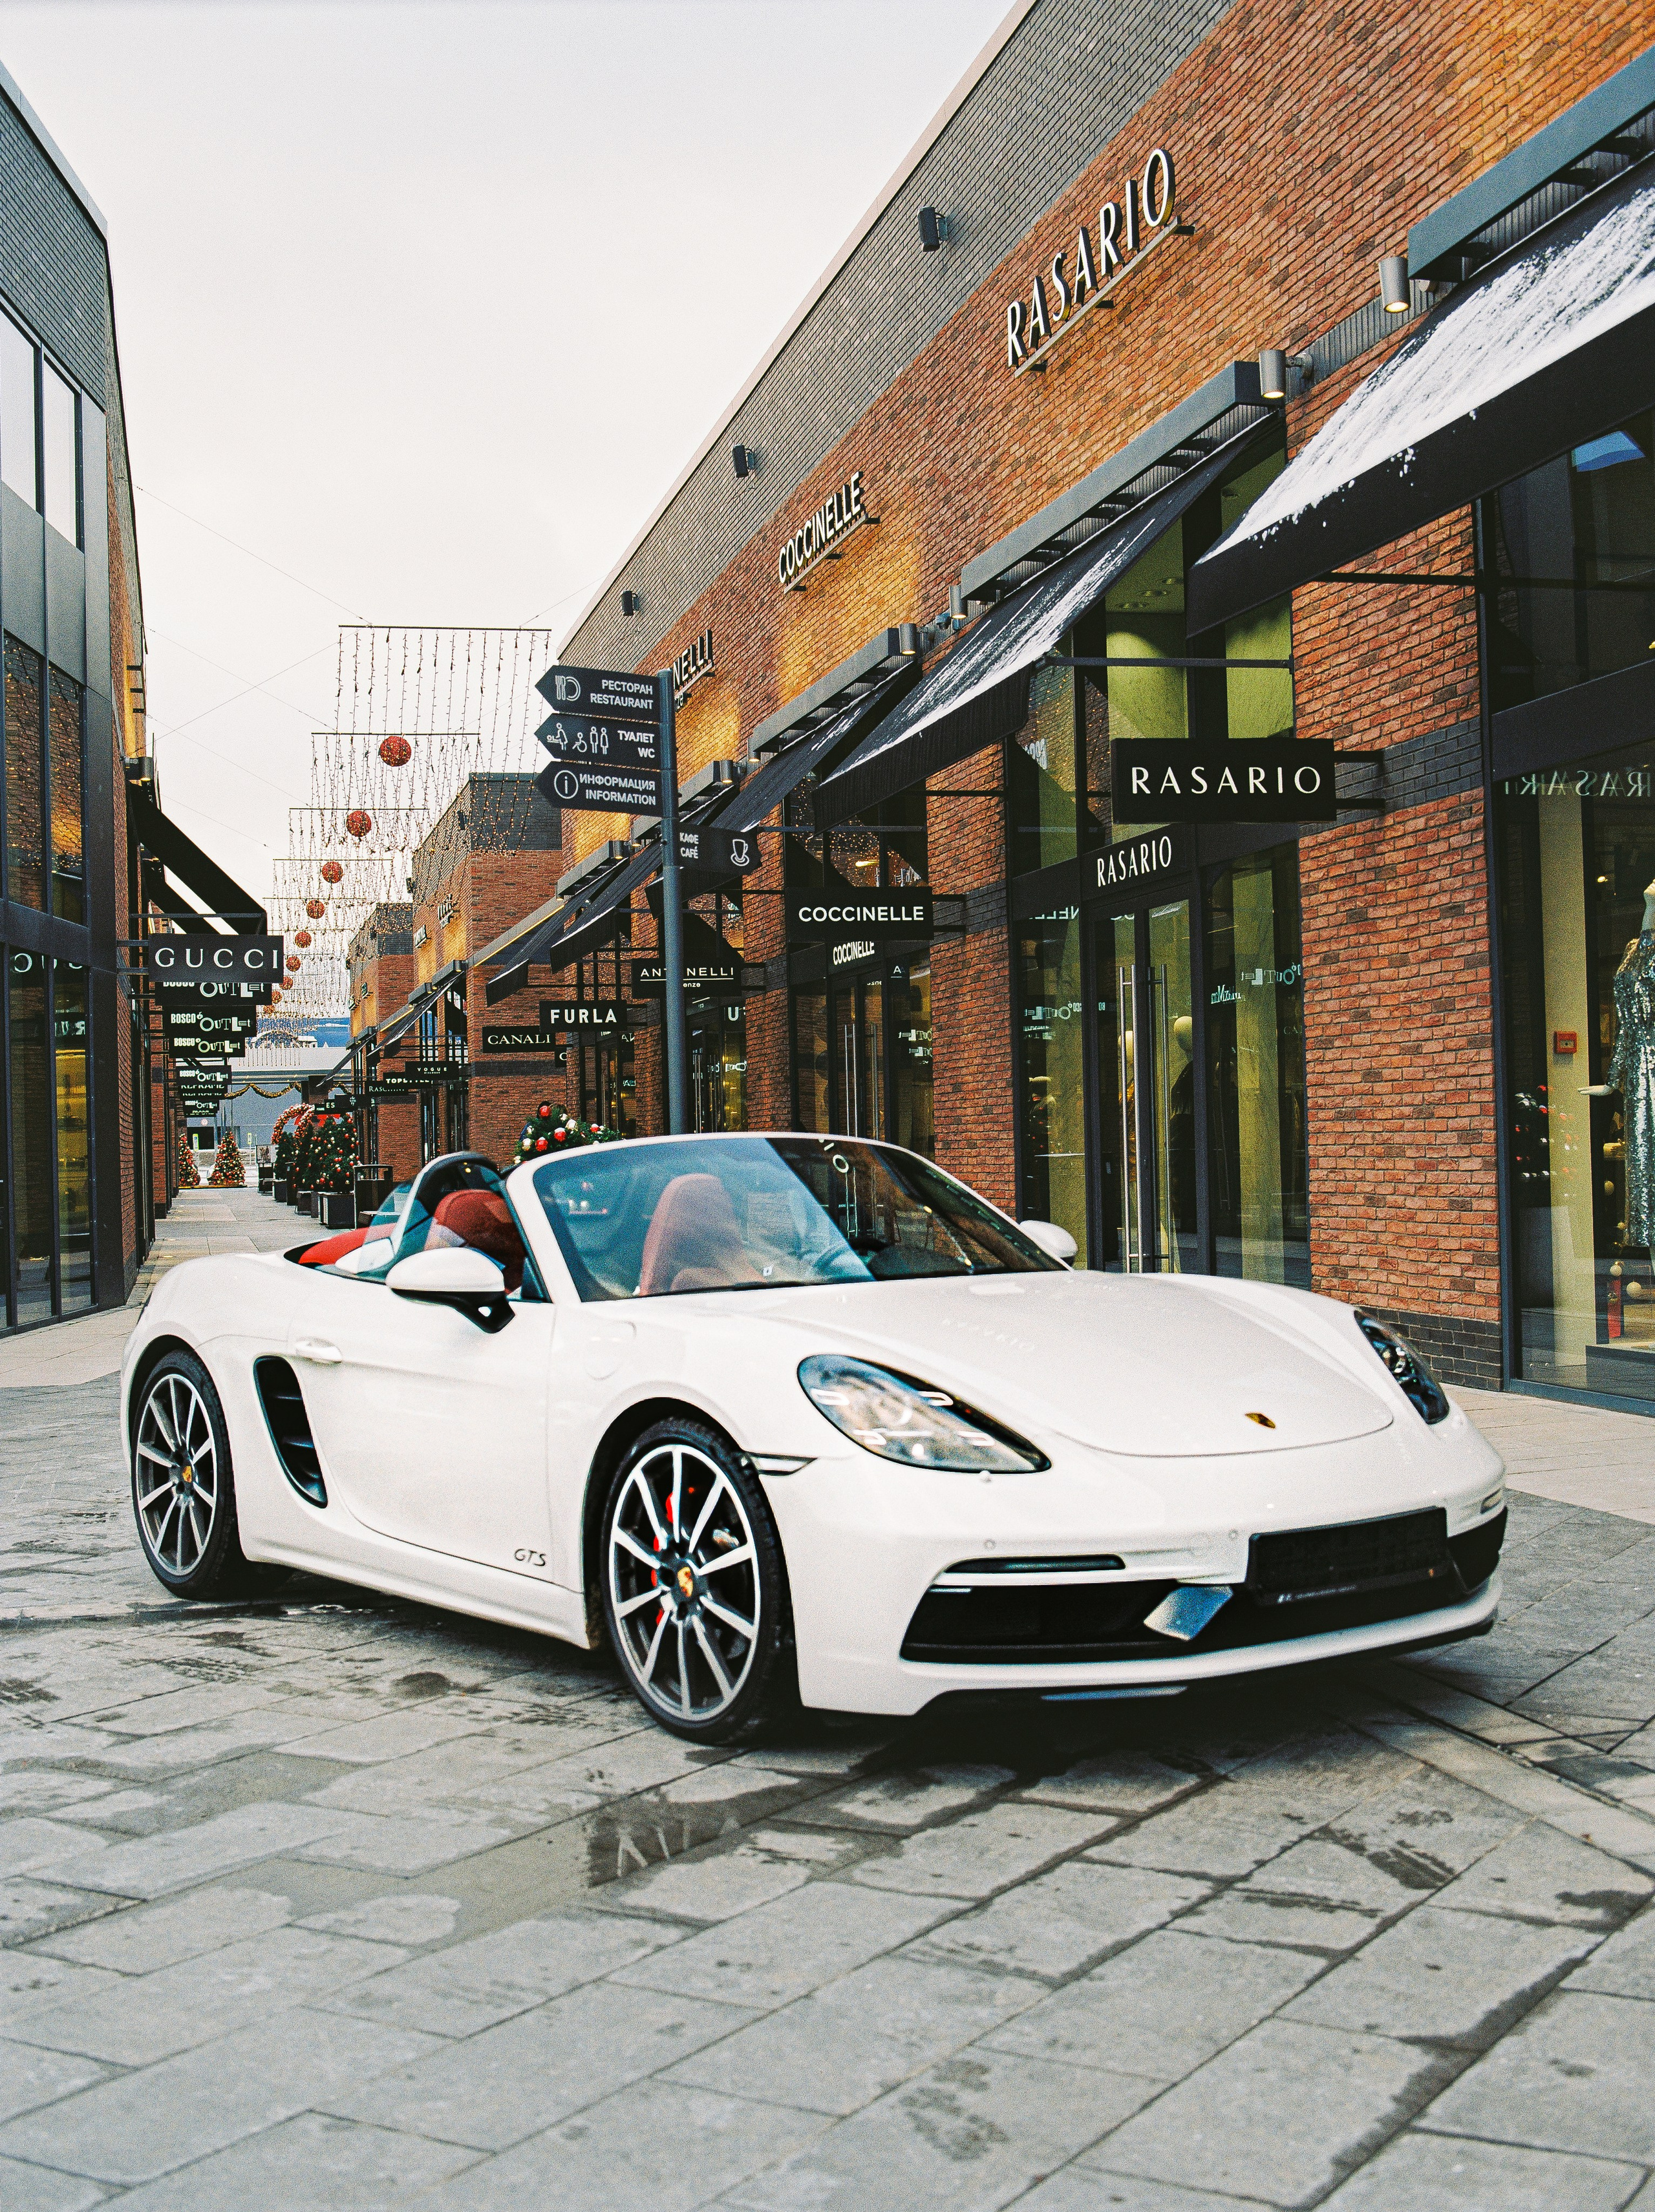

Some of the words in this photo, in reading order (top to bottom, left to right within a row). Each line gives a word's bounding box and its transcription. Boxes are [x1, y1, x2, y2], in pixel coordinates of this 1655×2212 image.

[1007, 148, 1173, 367] RASARIO
[779, 471, 861, 583] COCCINELLE
[673, 629, 712, 690] NELLI
[602, 679, 653, 695] РЕСТОРАН
[590, 694, 654, 710] RESTAURANT
[617, 730, 654, 743] ТУАЛЕТ
[638, 747, 655, 758] WC
[579, 774, 656, 791] ИНФОРМАЦИЯ
[1132, 766, 1320, 794] RASARIO
[586, 789, 656, 805] INFORMATION
[679, 833, 699, 844] КАФЕ
[681, 846, 698, 859] CAFÉ
[1097, 836, 1171, 887] RASARIO
[798, 907, 924, 922] COCCINELLE
[155, 948, 277, 968] GUCCI
[833, 941, 875, 965] COCCINELLE
[641, 968, 734, 977] ANNELLI
[171, 1014, 196, 1023] BOSCO
[551, 1008, 617, 1024] FURLA
[174, 1038, 195, 1047] BOSCO
[487, 1034, 550, 1045] CANALI
[515, 1549, 546, 1566] GTS
